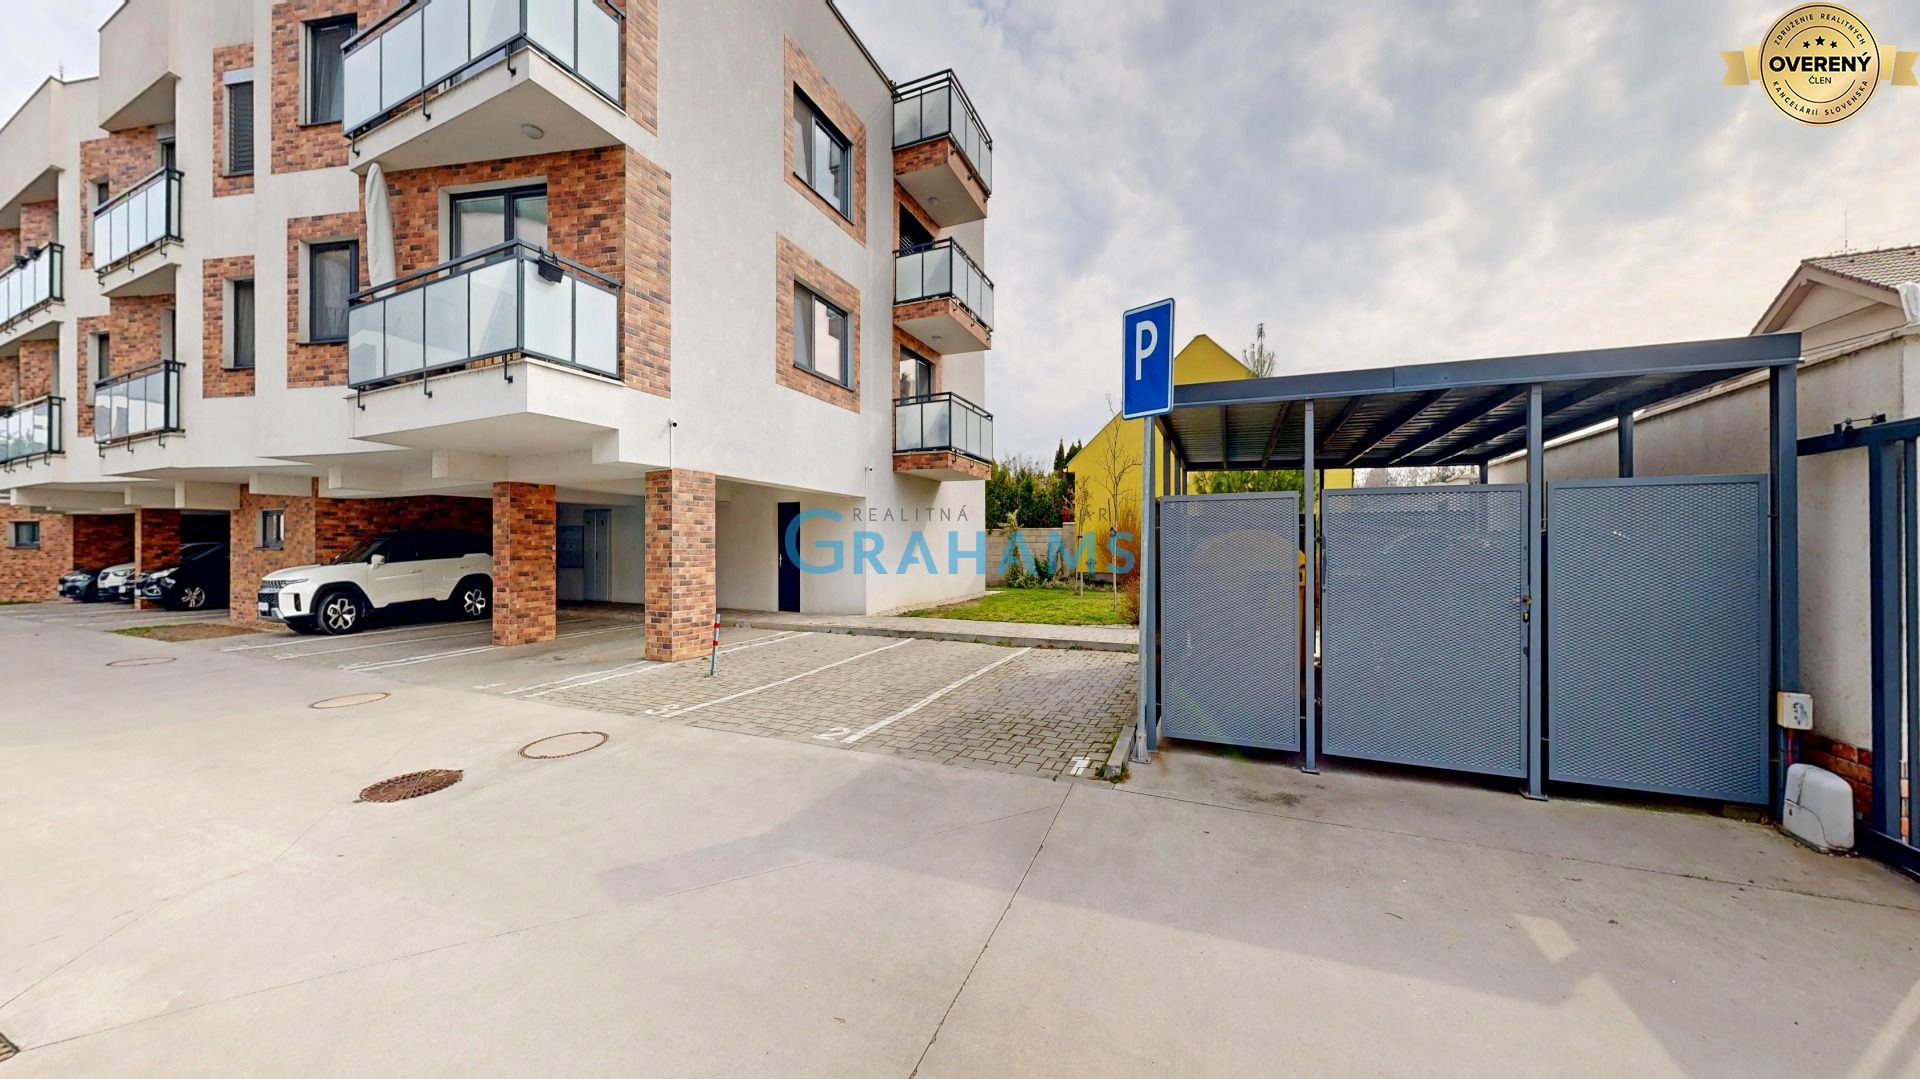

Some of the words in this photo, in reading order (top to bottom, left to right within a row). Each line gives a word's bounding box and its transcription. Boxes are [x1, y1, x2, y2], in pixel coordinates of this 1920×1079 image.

[1135, 319, 1158, 381] P
[812, 726, 851, 741] 2
[1070, 756, 1091, 777] 1
